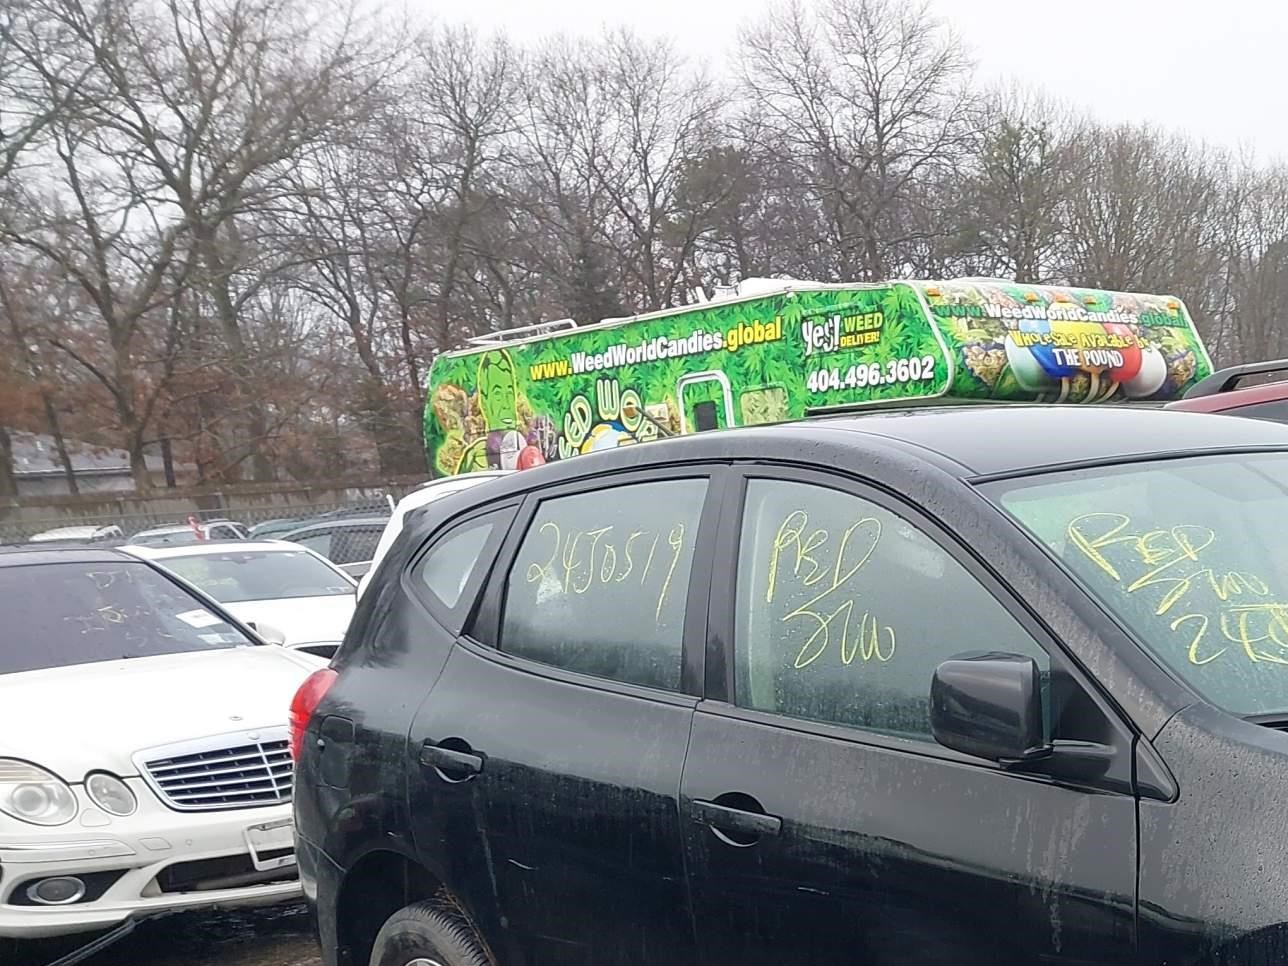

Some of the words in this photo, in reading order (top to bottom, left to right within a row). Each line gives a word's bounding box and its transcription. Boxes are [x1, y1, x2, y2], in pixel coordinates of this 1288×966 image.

[844, 312, 883, 332] WEED
[530, 315, 783, 380] www.WeedWorldCandies.global
[840, 331, 880, 347] DELIVER!
[1052, 349, 1081, 366] THE
[1083, 350, 1124, 369] POUND
[807, 356, 935, 393] 404.496.3602
